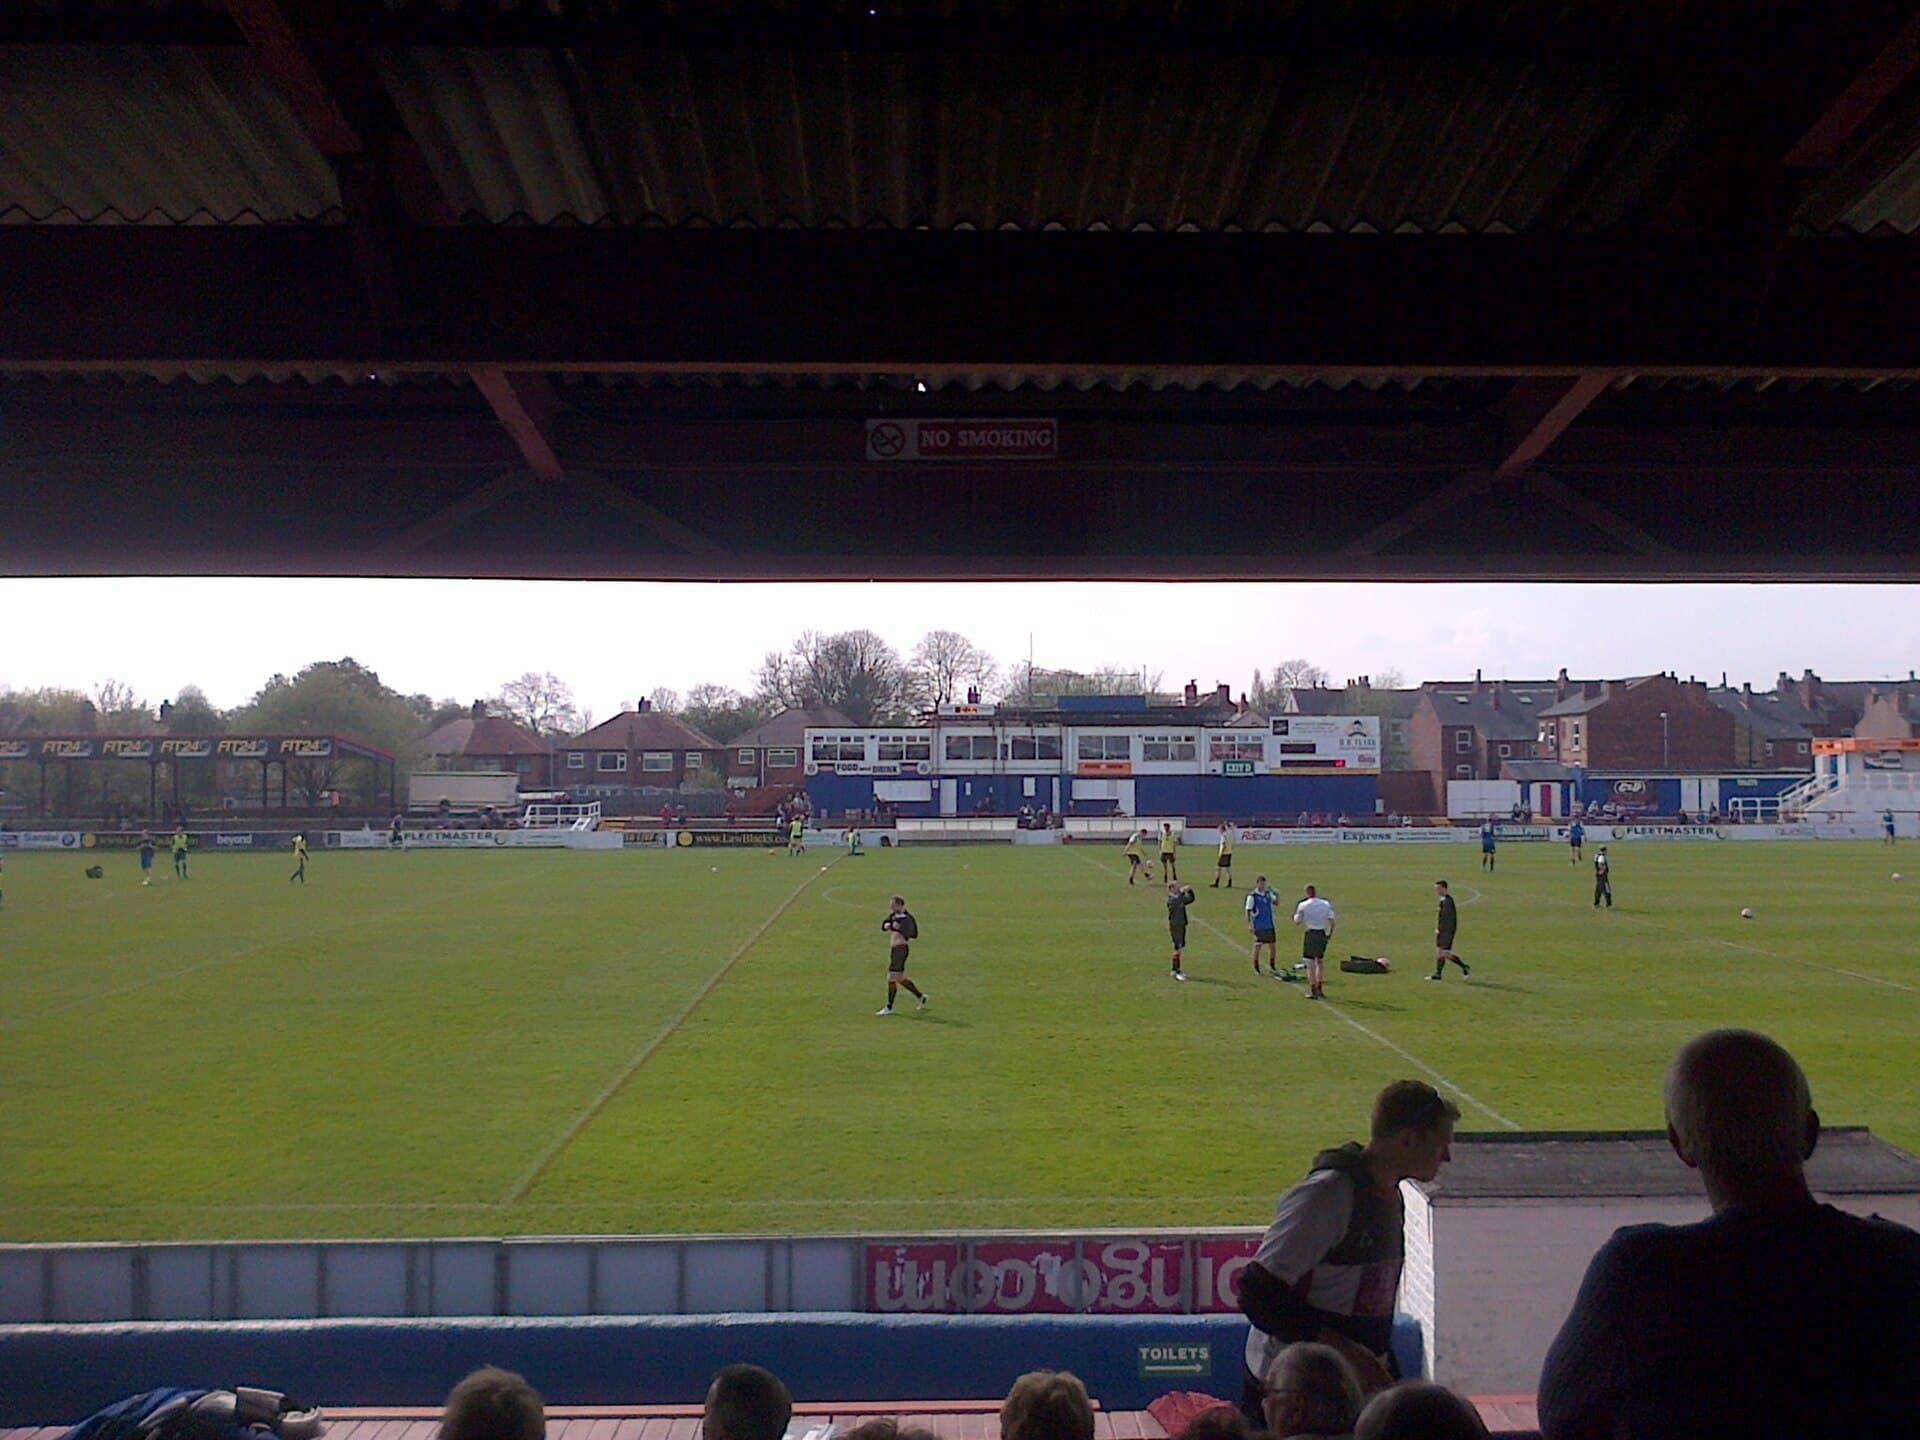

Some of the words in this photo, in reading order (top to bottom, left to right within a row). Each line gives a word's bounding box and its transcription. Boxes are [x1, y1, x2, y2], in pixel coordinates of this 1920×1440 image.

[920, 430, 951, 448] NO
[957, 430, 1052, 448] SMOKING
[404, 831, 493, 840] FLEETMASTER
[1626, 826, 1714, 835] FLEETMASTER
[1343, 831, 1392, 842] Express
[1139, 1347, 1209, 1360] TOILETS
